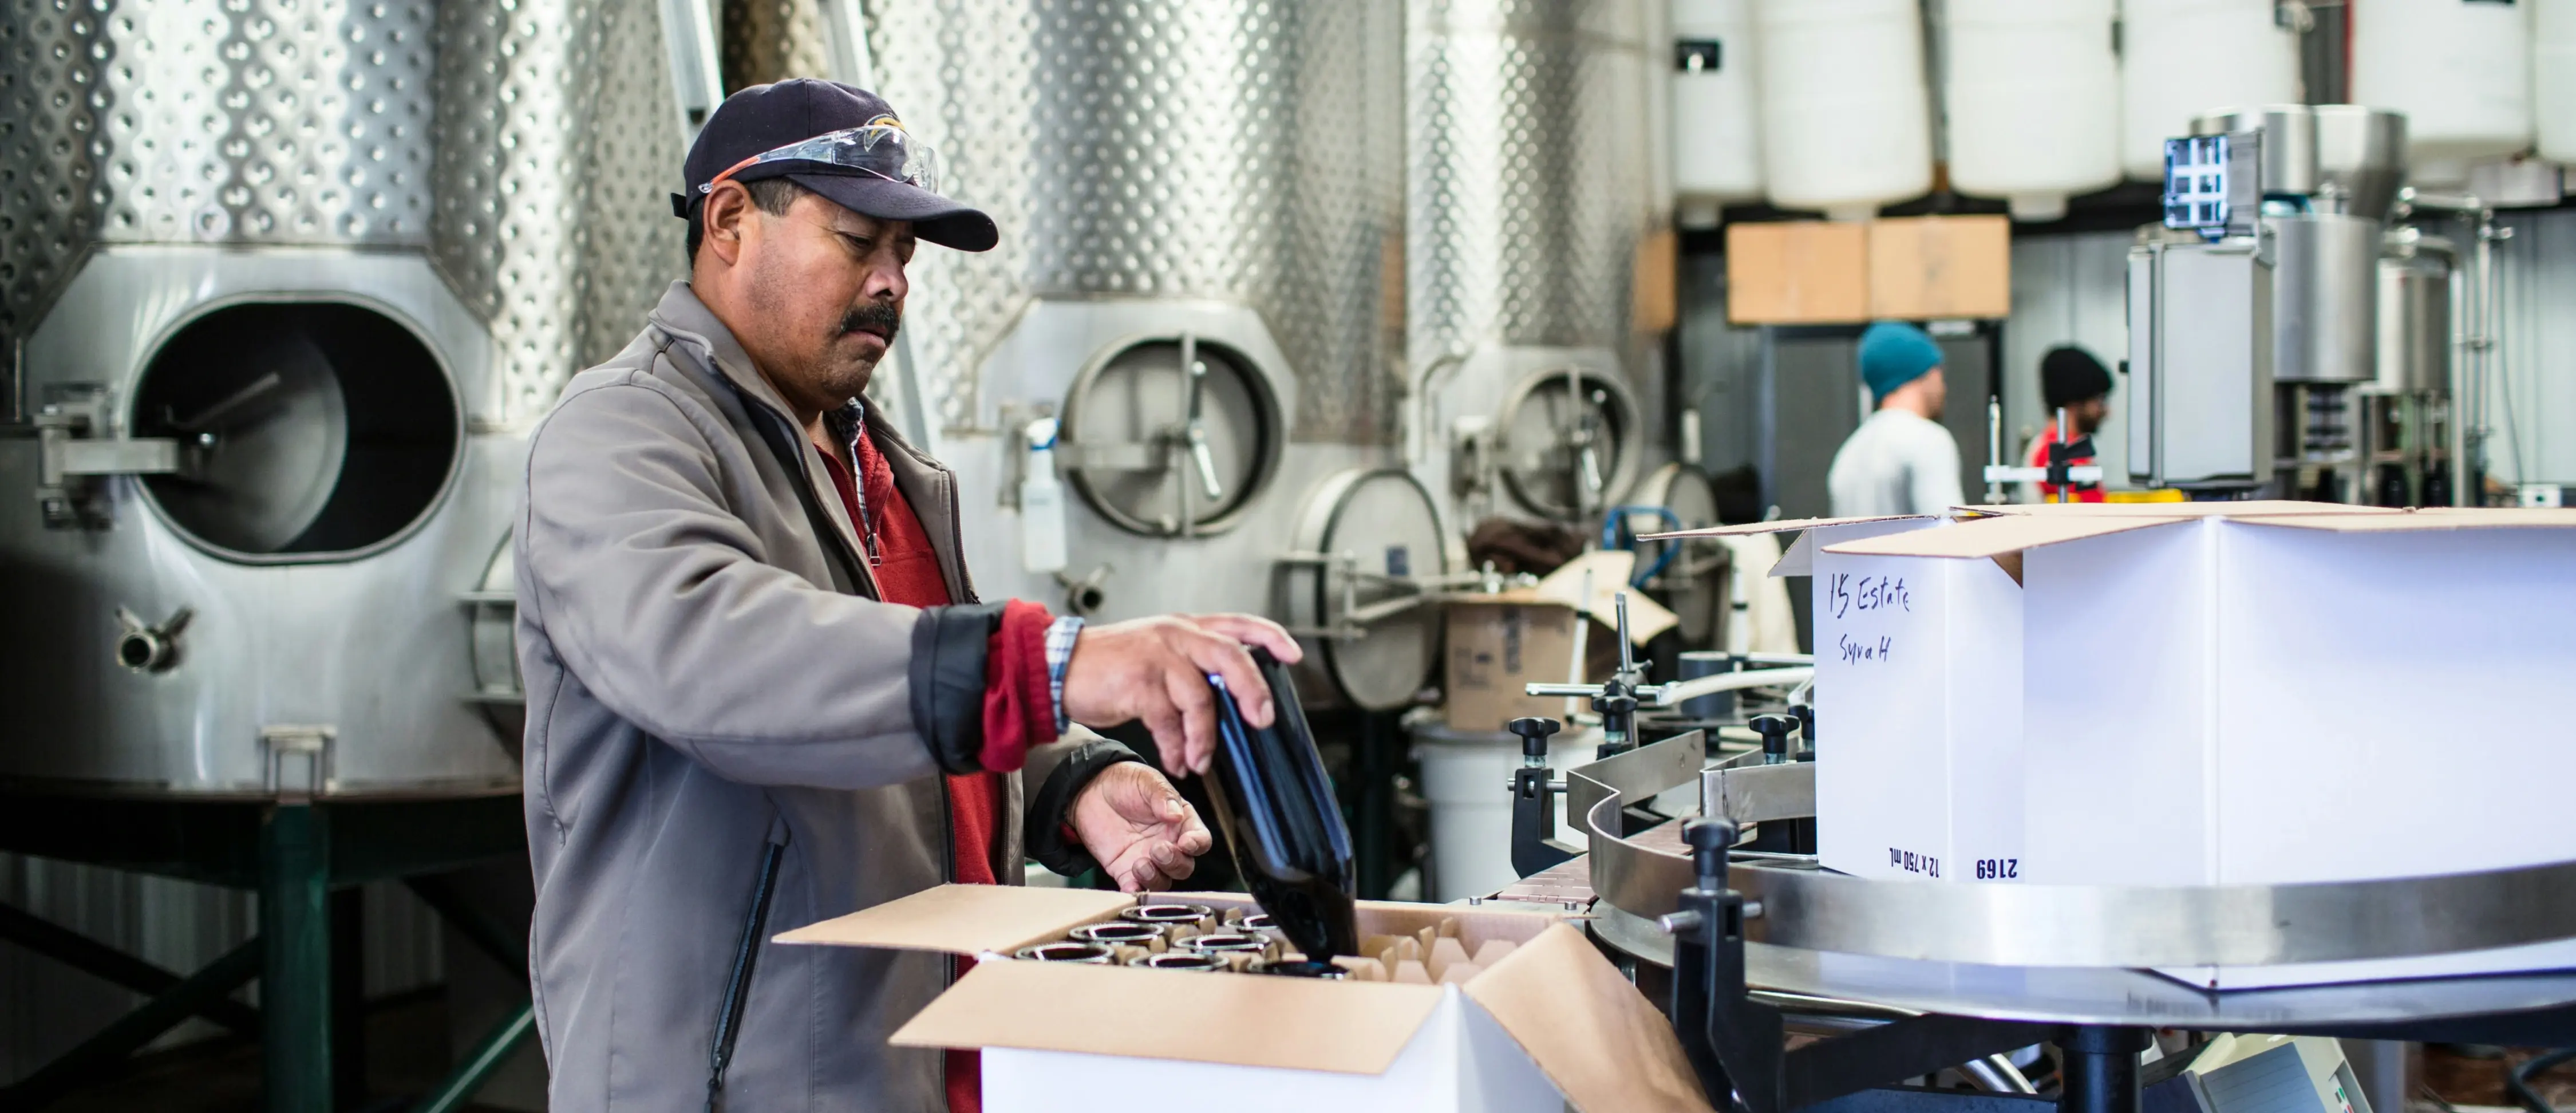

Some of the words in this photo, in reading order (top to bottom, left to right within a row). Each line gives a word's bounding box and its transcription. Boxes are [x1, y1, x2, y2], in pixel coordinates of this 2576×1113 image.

[1830, 573, 1849, 619] 15
[1857, 575, 1910, 612] Estate
[1889, 847, 1902, 867] mL
[1903, 851, 1919, 873] 750
[1922, 855, 1927, 871] x
[1929, 857, 1939, 878] 12
[1976, 858, 2017, 879] 2169
